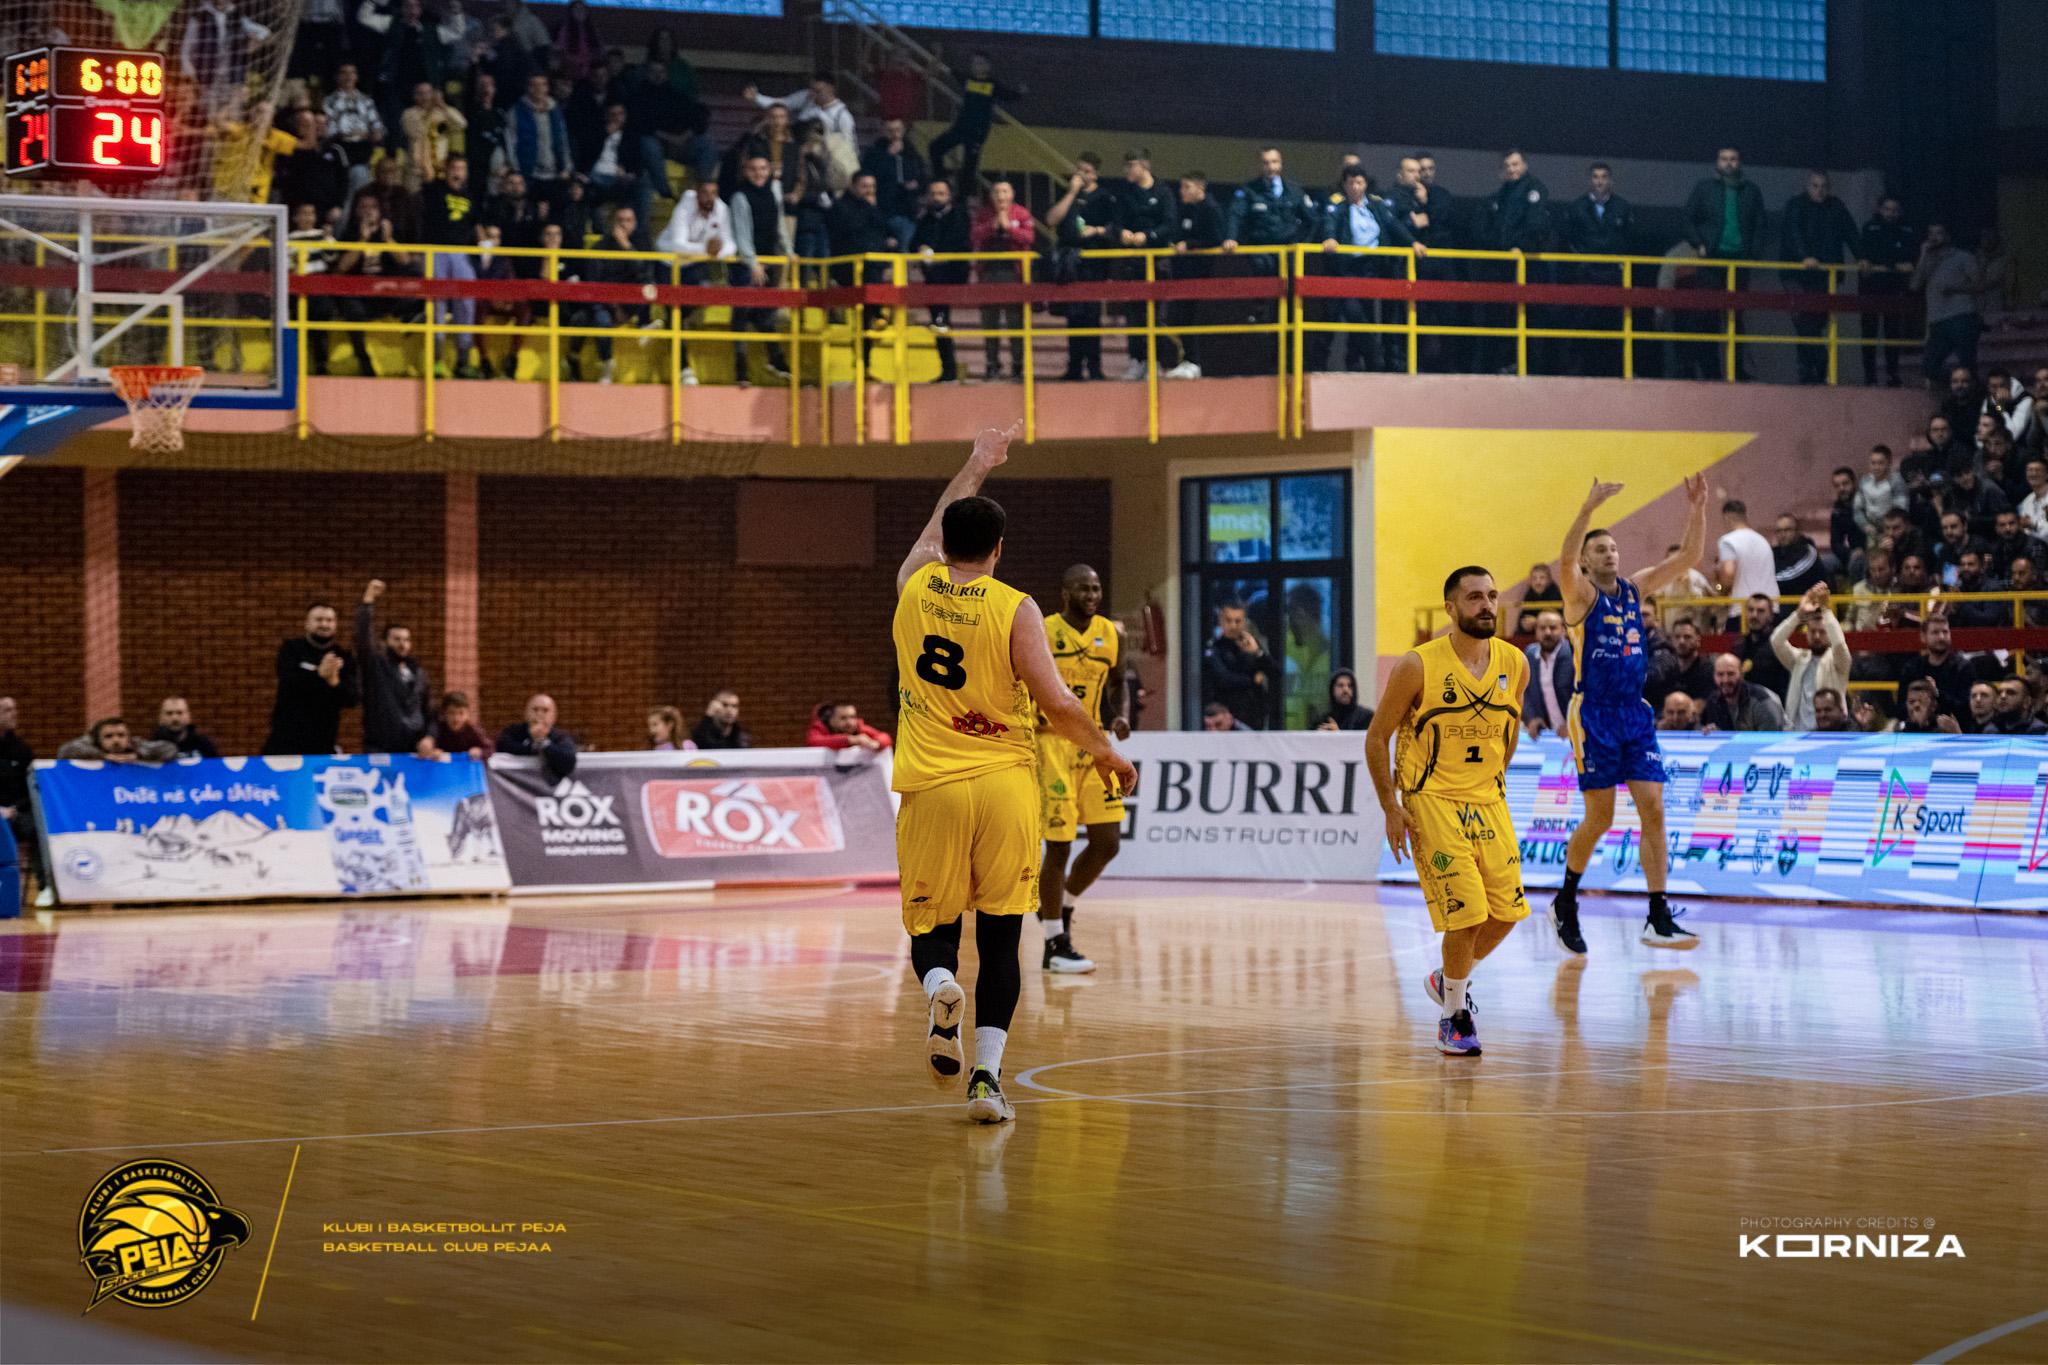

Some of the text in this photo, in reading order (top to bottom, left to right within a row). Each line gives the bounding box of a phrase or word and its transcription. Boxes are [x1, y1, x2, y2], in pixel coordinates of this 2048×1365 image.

[81, 58, 162, 95] 6:00
[20, 113, 49, 166] 24
[92, 112, 161, 165] 24
[921, 599, 980, 626] VESELI
[916, 635, 967, 690] 8
[1444, 725, 1502, 739] PEJA
[1465, 746, 1483, 763] 1
[1153, 759, 1361, 816] BURRI
[541, 828, 626, 843] MOVING
[1532, 818, 1564, 831] SPORT
[1894, 804, 1966, 837] K Sport
[1147, 825, 1359, 847] CONSTRUCTION
